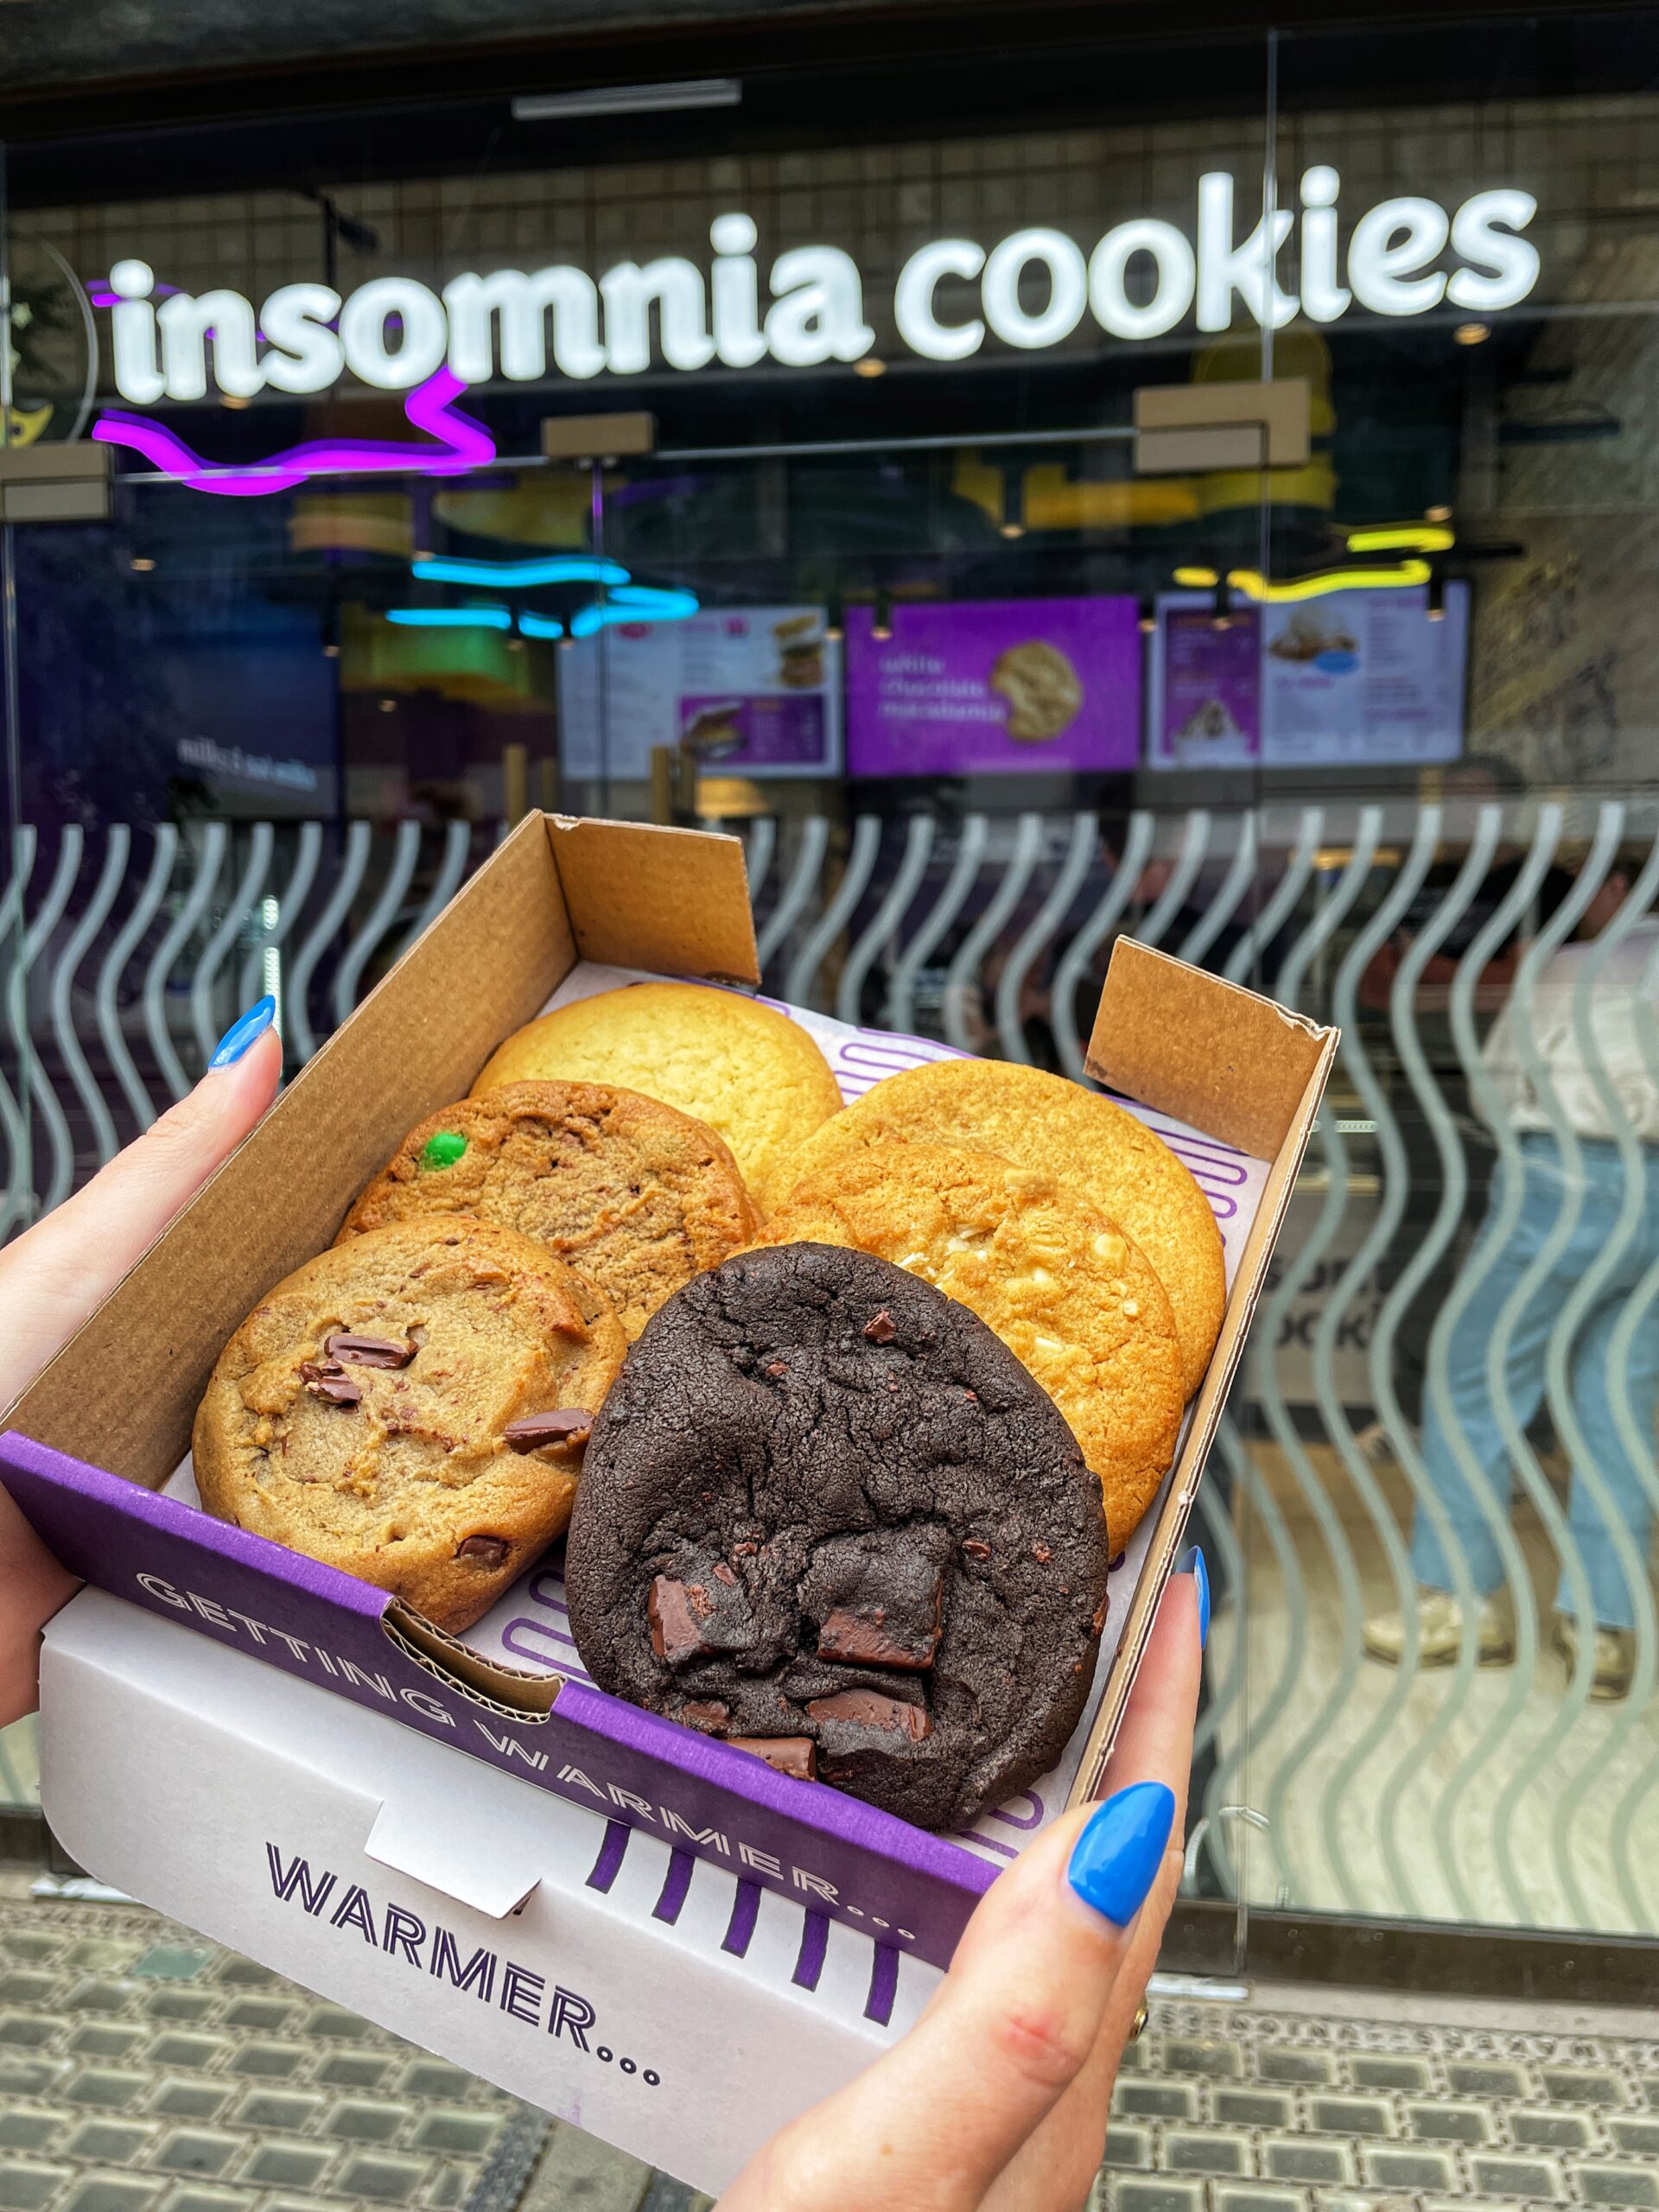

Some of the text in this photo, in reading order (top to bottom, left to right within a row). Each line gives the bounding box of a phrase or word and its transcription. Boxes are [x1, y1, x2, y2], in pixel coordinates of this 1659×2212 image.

[109, 165, 1541, 404] insomnia cookies
[136, 1572, 456, 1728] GETTING
